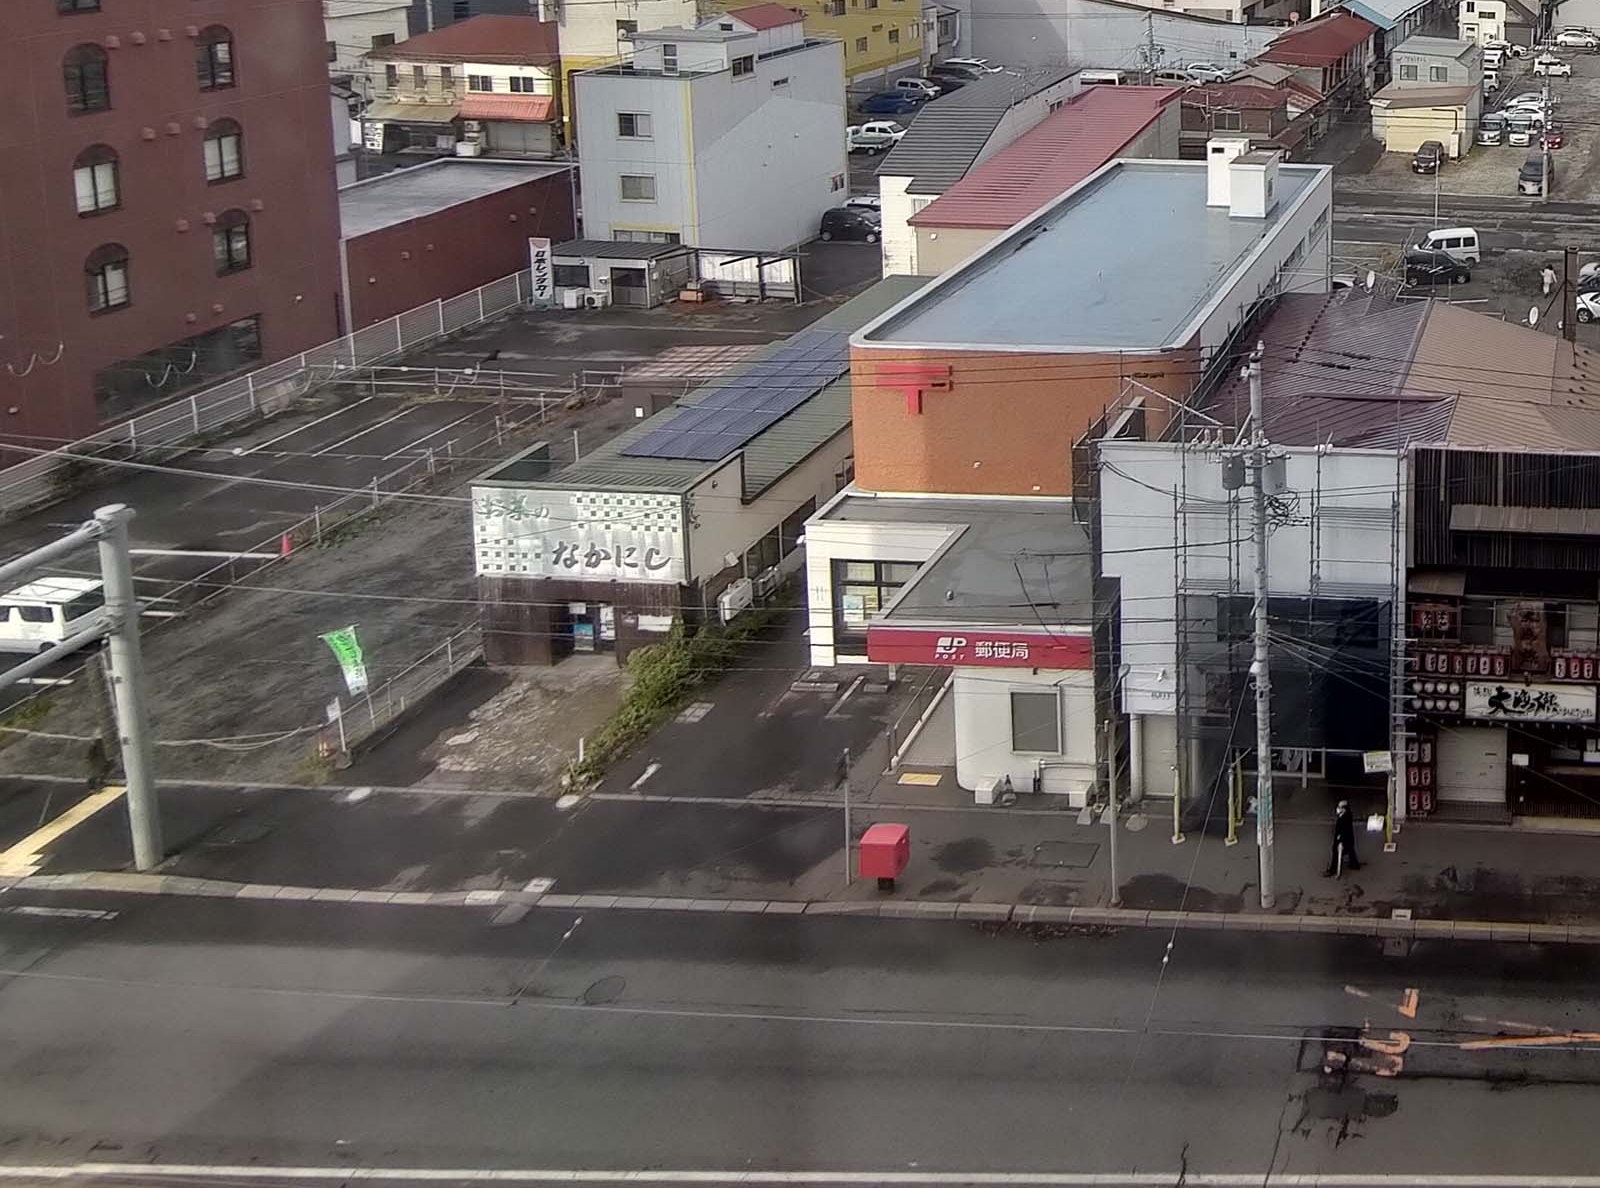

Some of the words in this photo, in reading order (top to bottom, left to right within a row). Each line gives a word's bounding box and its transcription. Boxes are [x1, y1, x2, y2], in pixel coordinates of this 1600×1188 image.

[533, 250, 548, 297] 日本レンタカー
[552, 540, 671, 570] なかにし
[975, 641, 1030, 660] 郵便局
